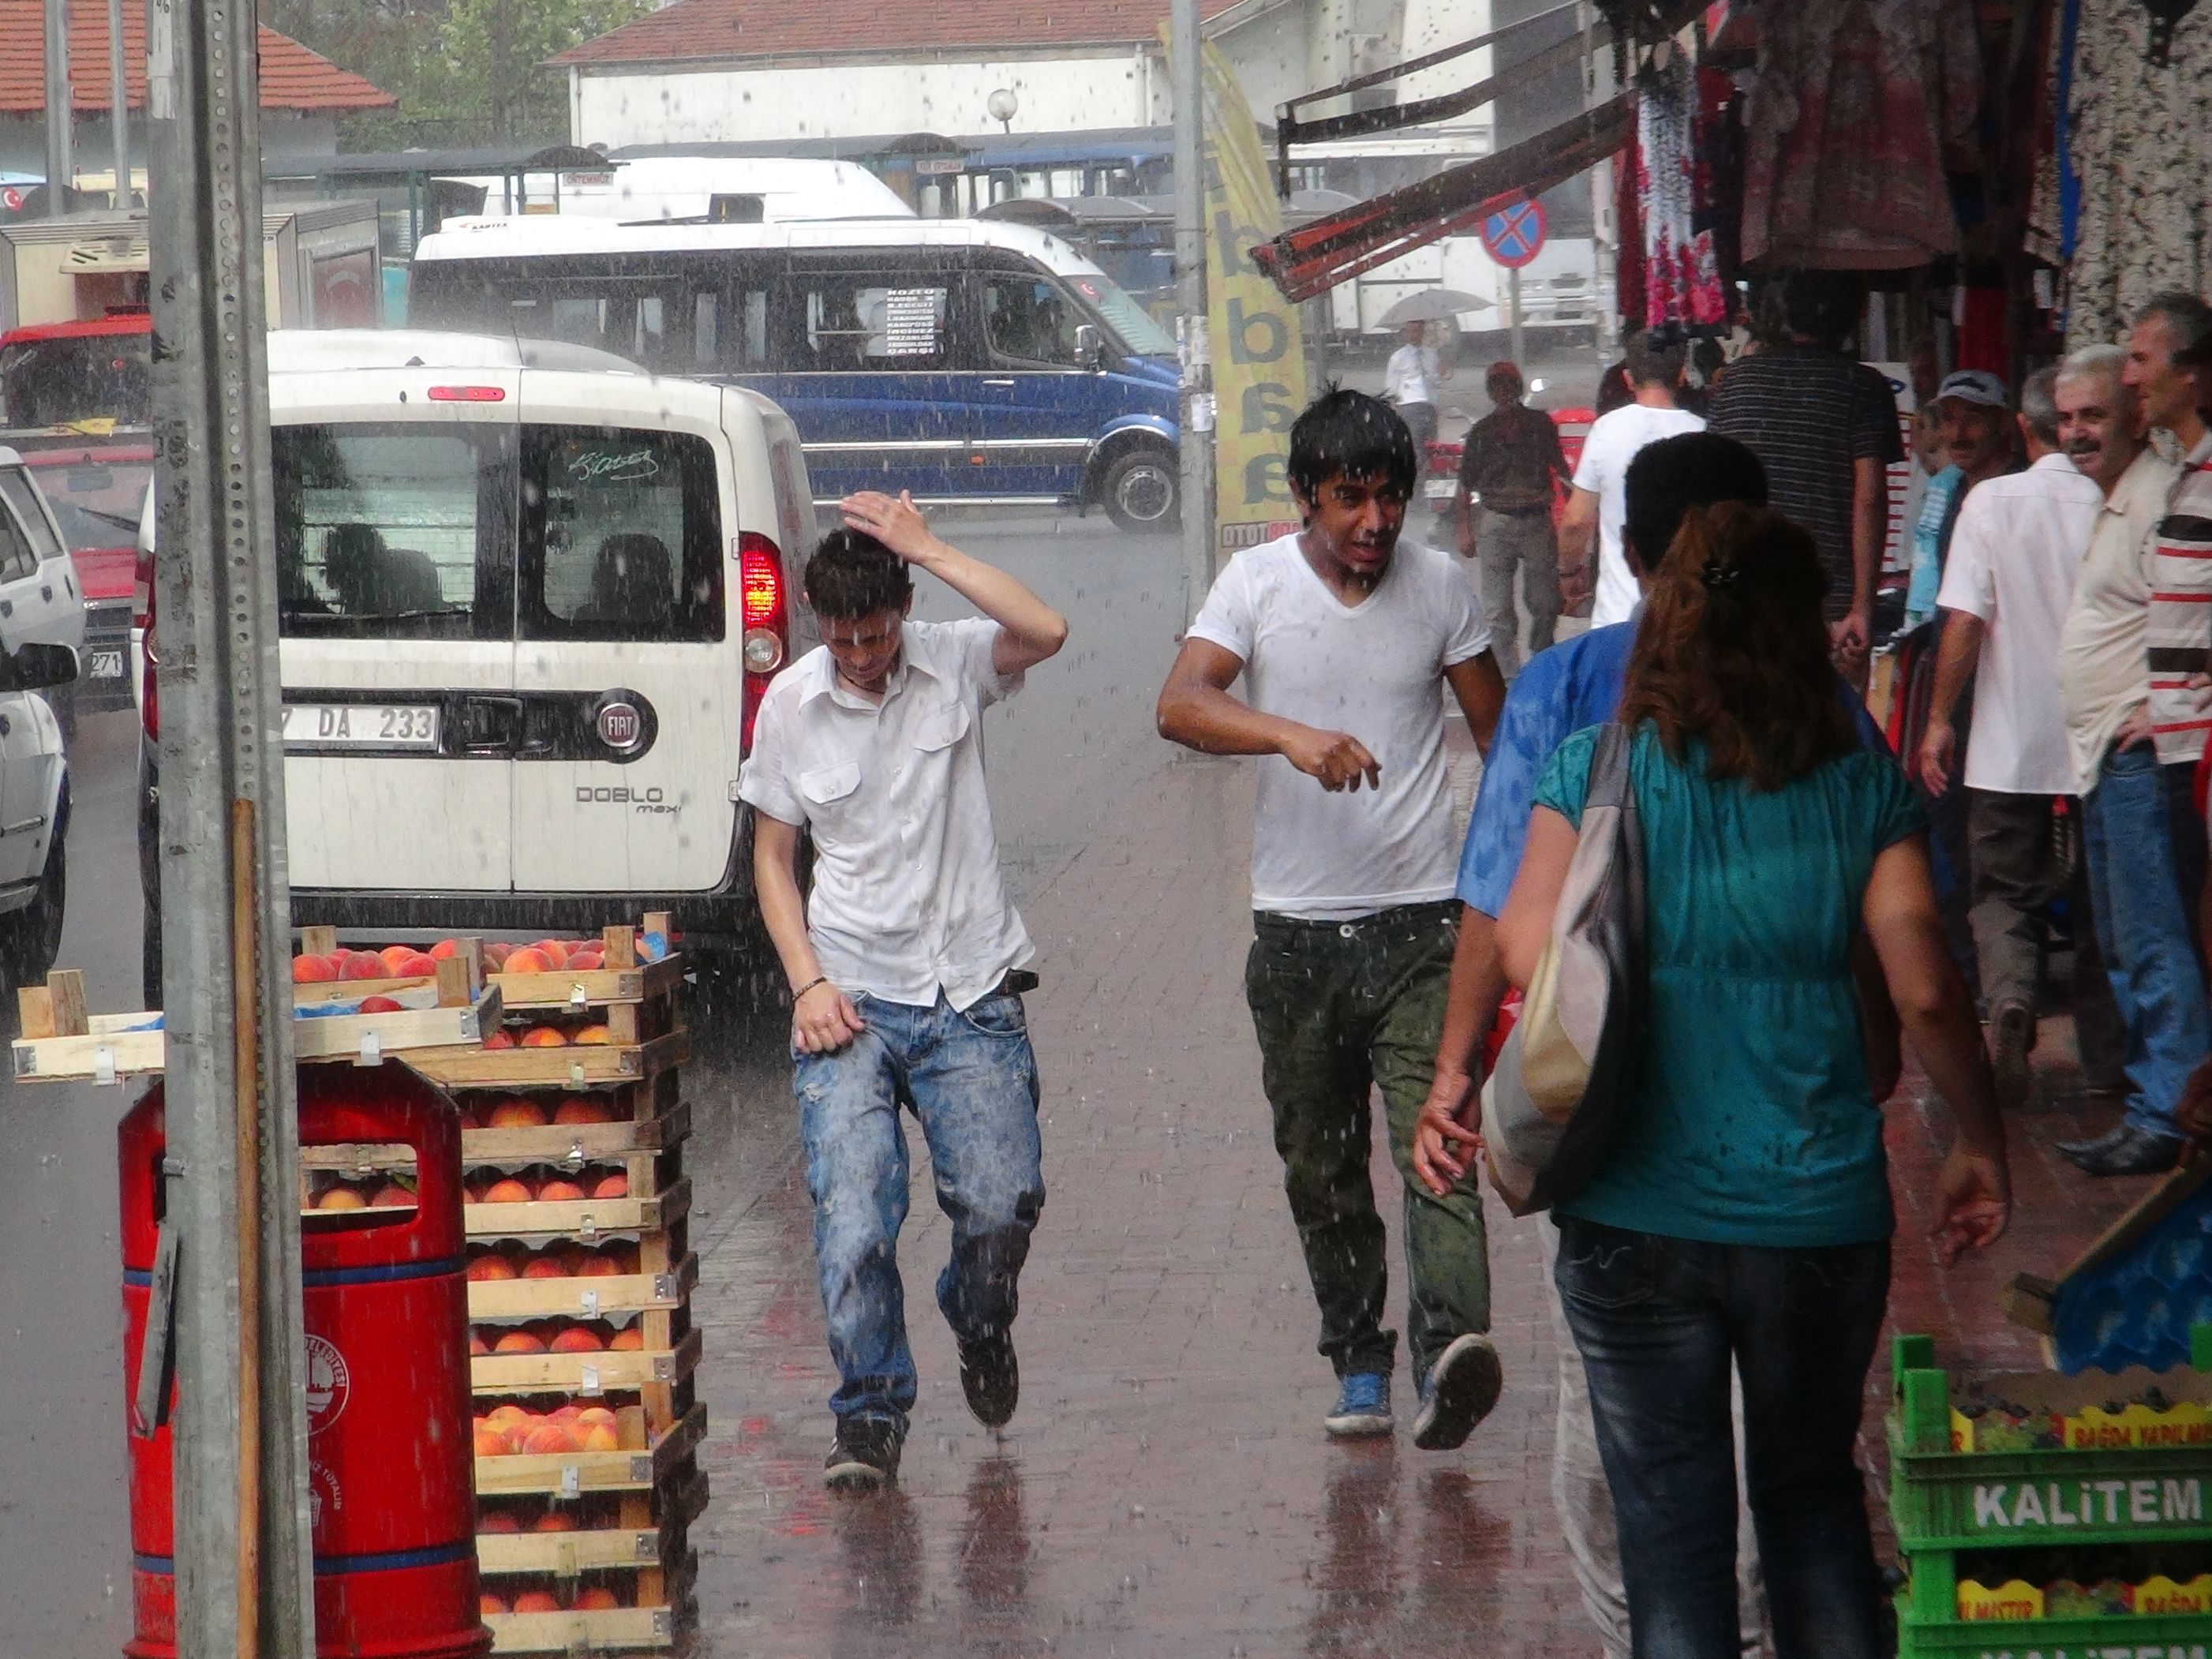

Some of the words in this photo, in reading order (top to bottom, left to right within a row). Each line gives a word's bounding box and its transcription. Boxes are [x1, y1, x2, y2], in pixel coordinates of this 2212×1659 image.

[91, 654, 118, 671] 271
[319, 708, 350, 738] DA
[380, 710, 432, 739] 233
[608, 717, 634, 736] FIAT
[576, 787, 663, 803] DOBLO
